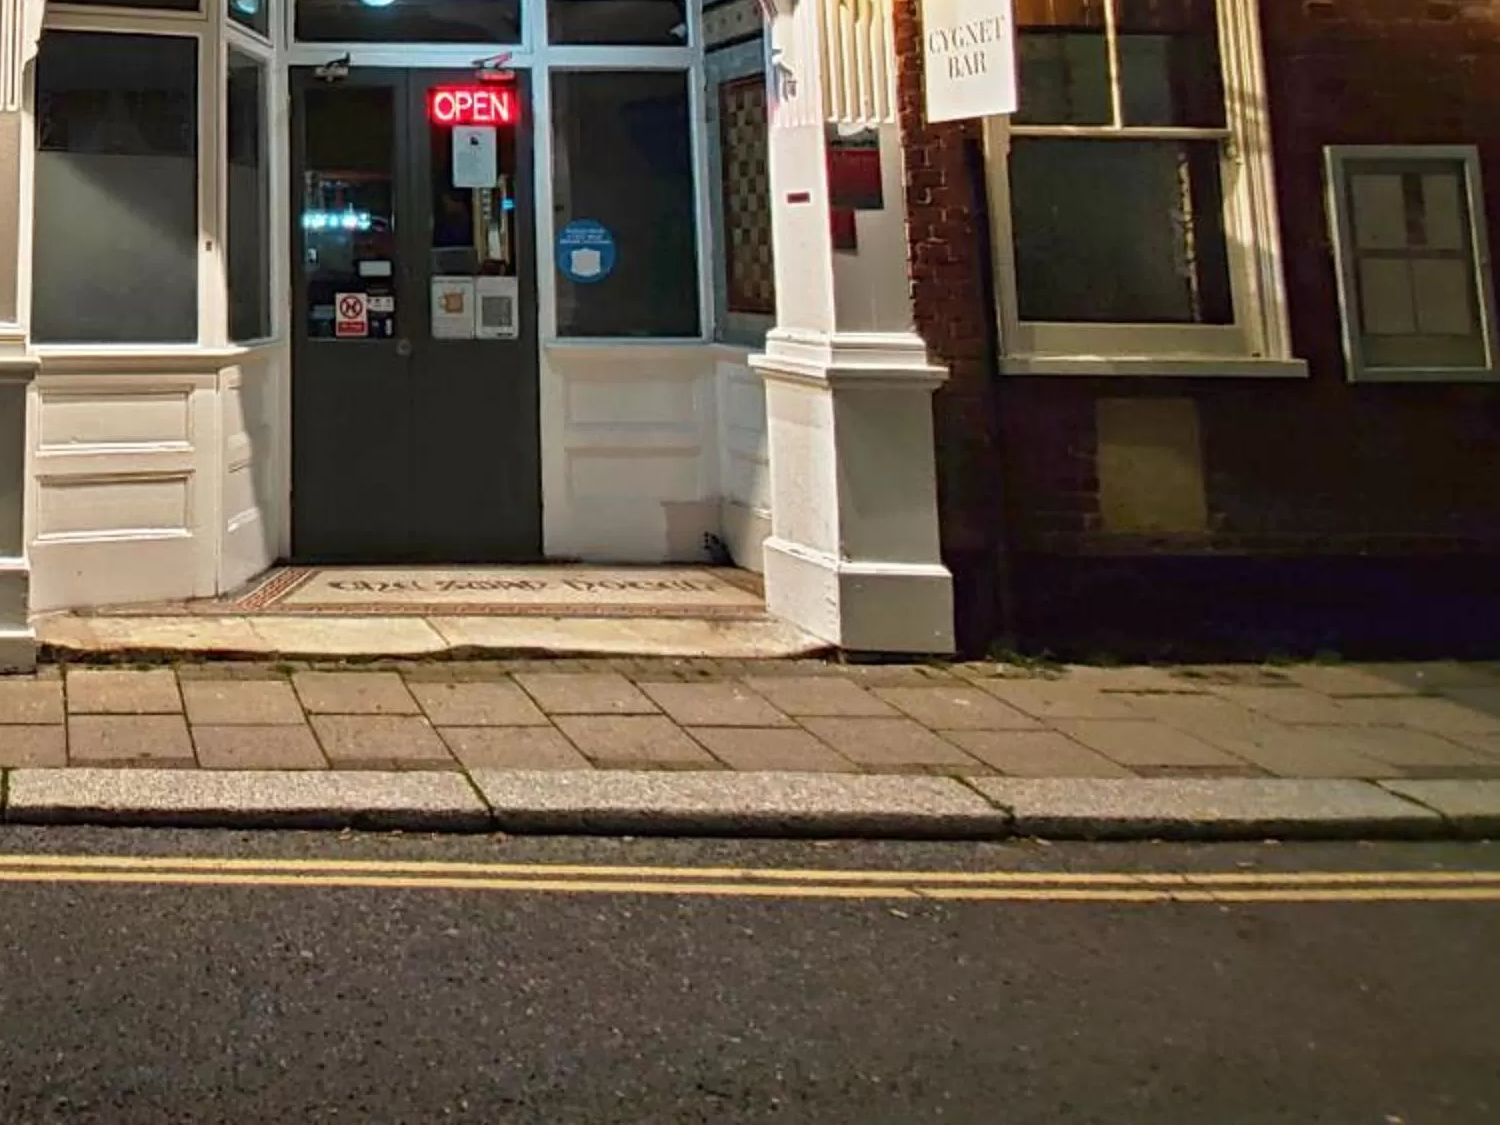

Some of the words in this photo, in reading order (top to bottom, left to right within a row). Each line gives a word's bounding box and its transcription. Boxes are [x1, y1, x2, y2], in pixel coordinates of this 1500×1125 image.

[929, 15, 1006, 55] CYGNET
[948, 50, 987, 80] BAR
[434, 90, 509, 122] OPEN
